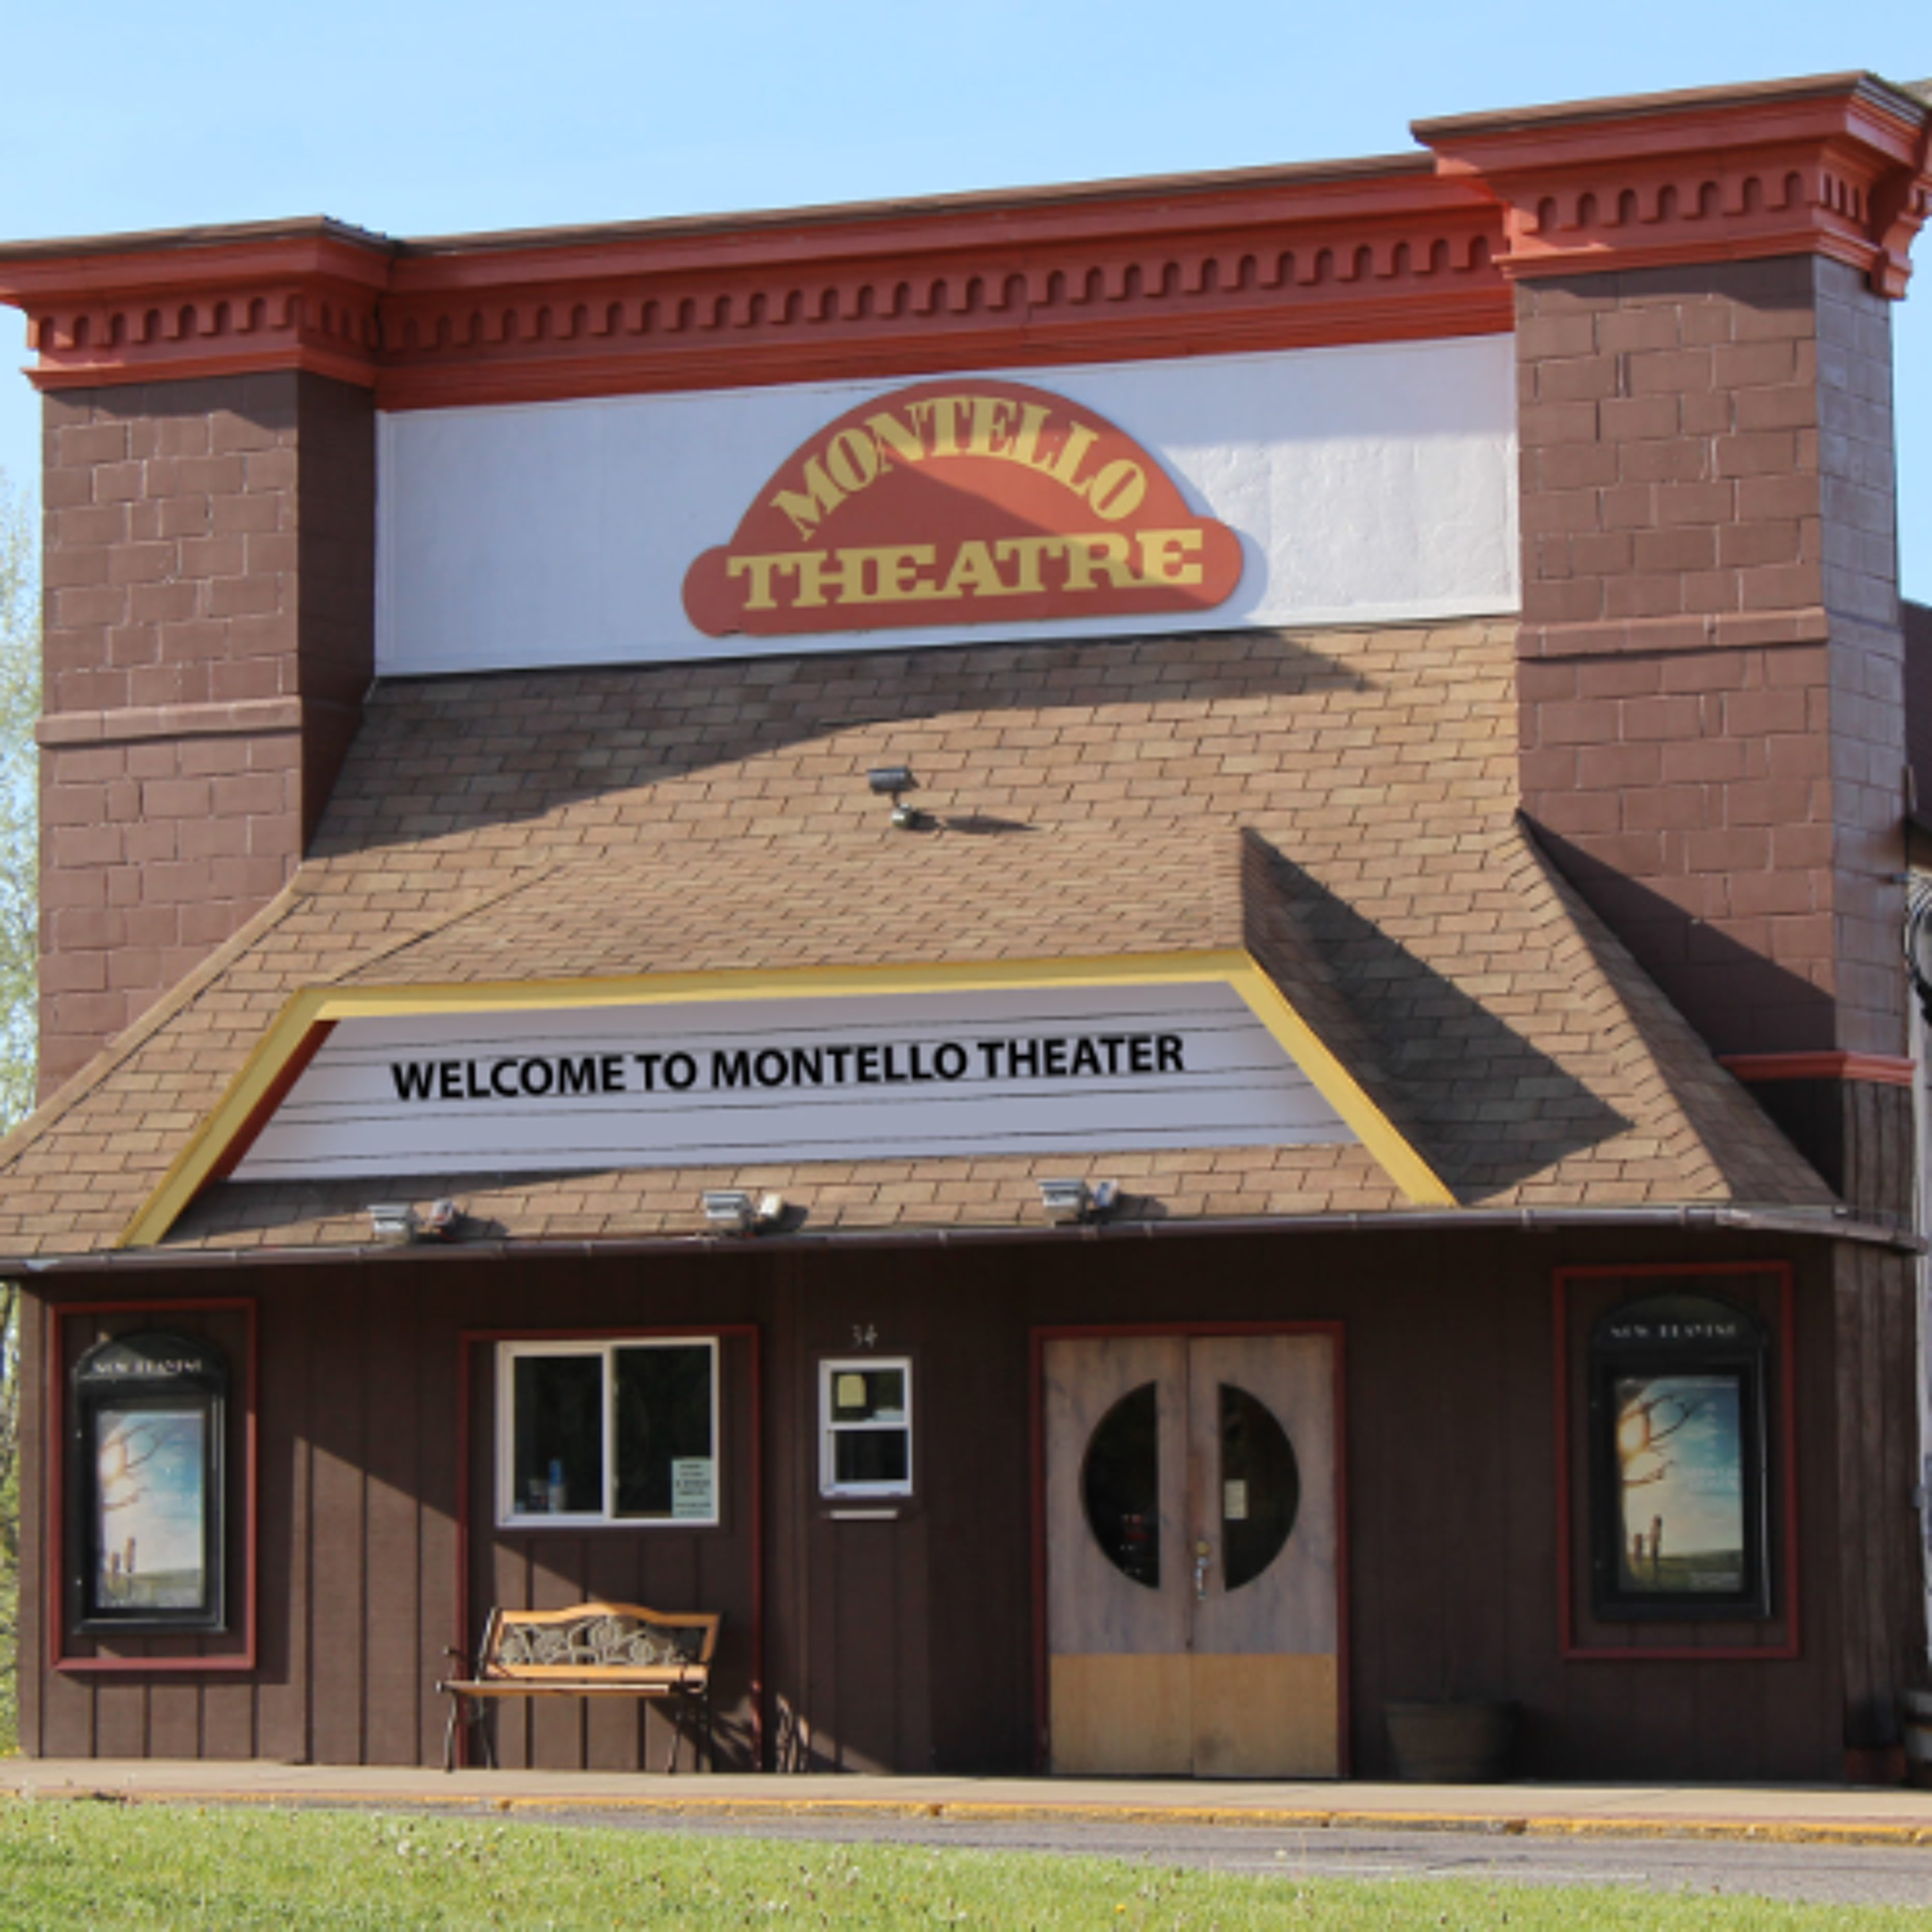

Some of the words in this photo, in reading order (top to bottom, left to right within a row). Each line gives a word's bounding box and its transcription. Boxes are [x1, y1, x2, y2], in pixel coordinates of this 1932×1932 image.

[771, 395, 1146, 542] MONTELLO
[726, 529, 1202, 610] THEATRE
[390, 1055, 626, 1100] WELCOME
[634, 1052, 698, 1090] TO
[711, 1042, 968, 1088] MONTELLO
[977, 1034, 1184, 1079] THEATER
